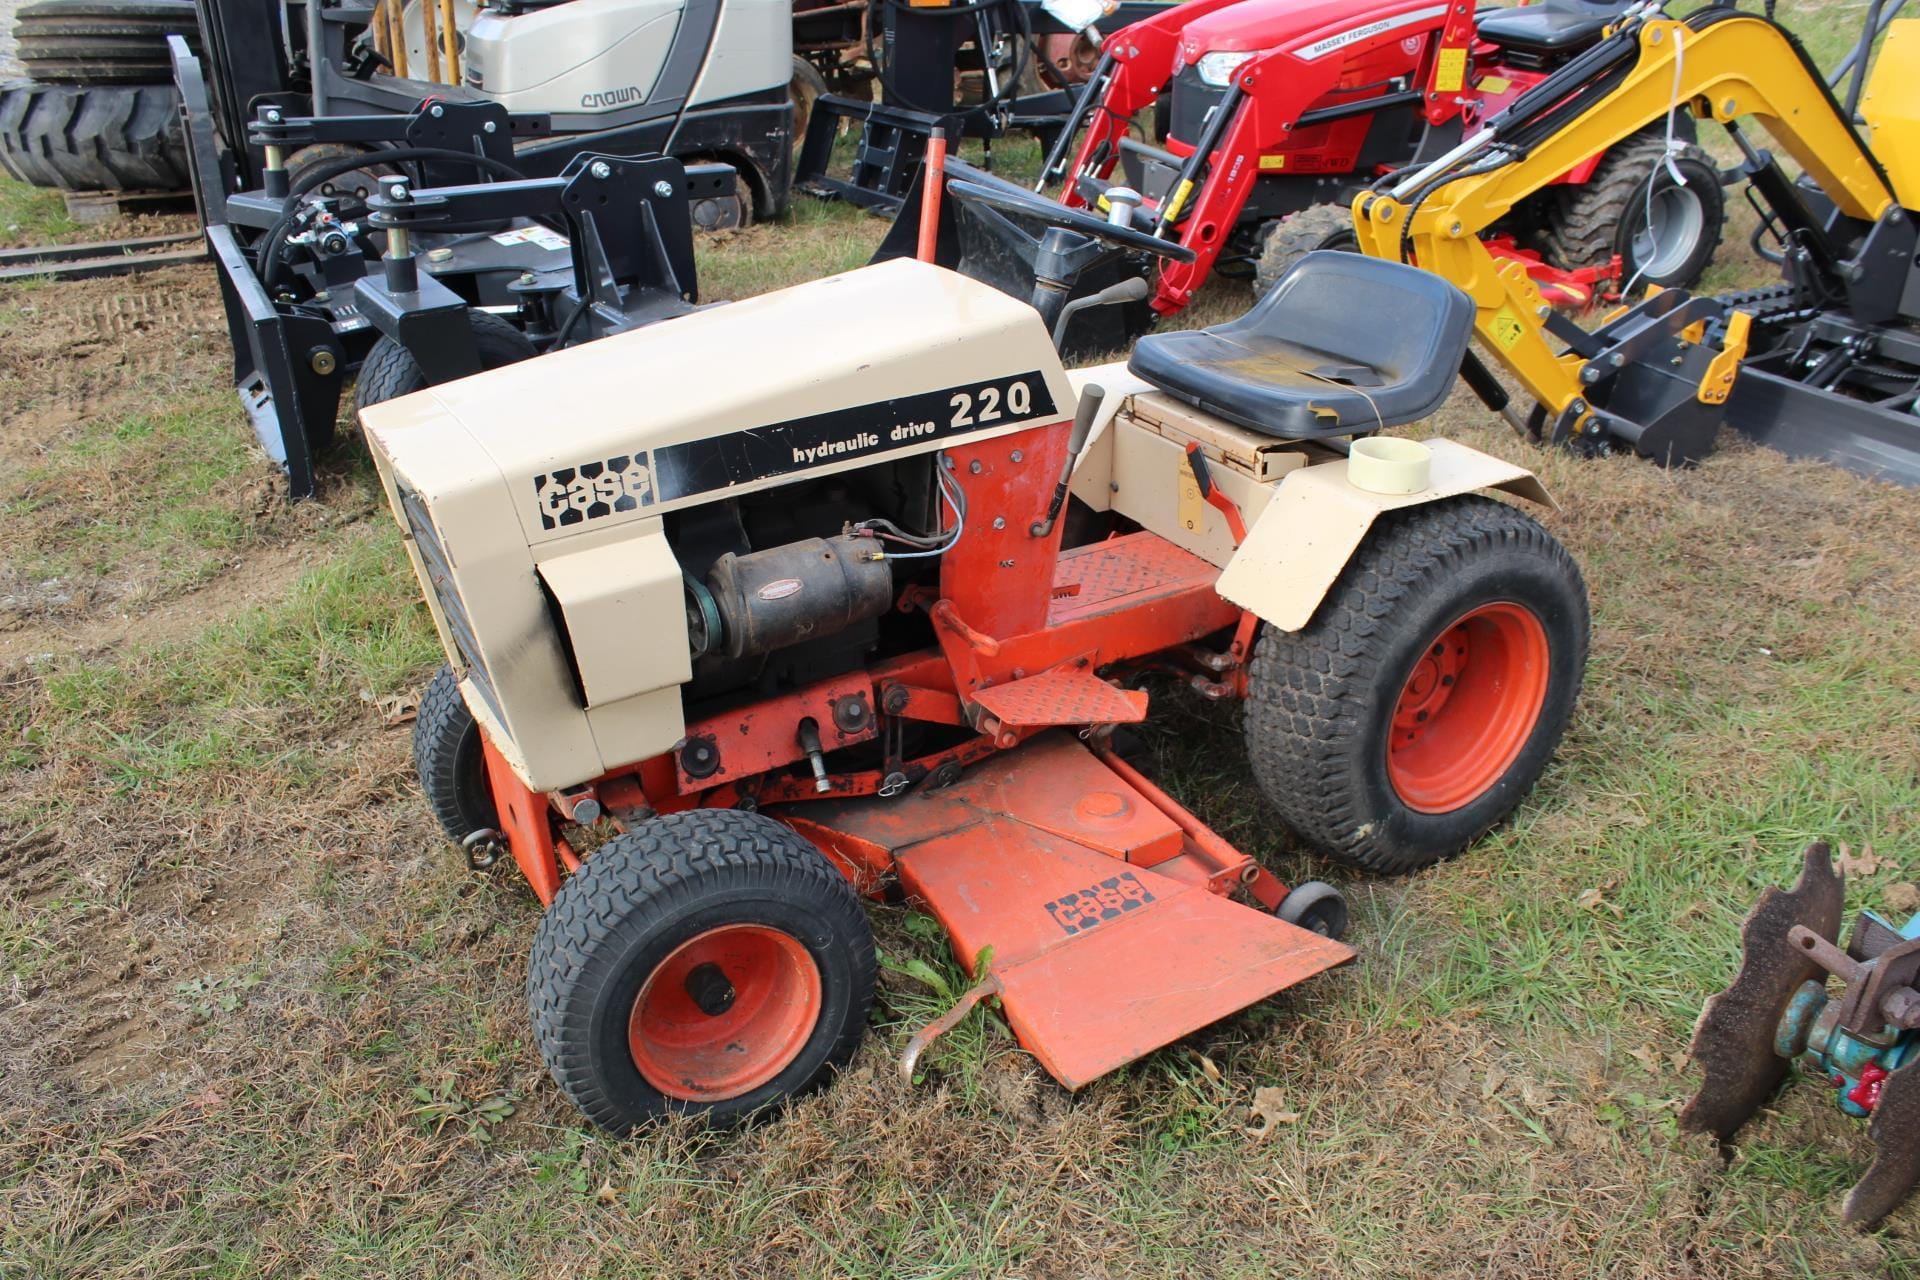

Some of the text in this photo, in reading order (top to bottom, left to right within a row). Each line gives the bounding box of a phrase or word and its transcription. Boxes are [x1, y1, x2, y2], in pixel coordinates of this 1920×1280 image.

[1313, 21, 1390, 53] MASSEY FERGUSON
[581, 86, 642, 108] CROWN
[793, 432, 879, 463] hydraulic
[890, 420, 936, 441] drive
